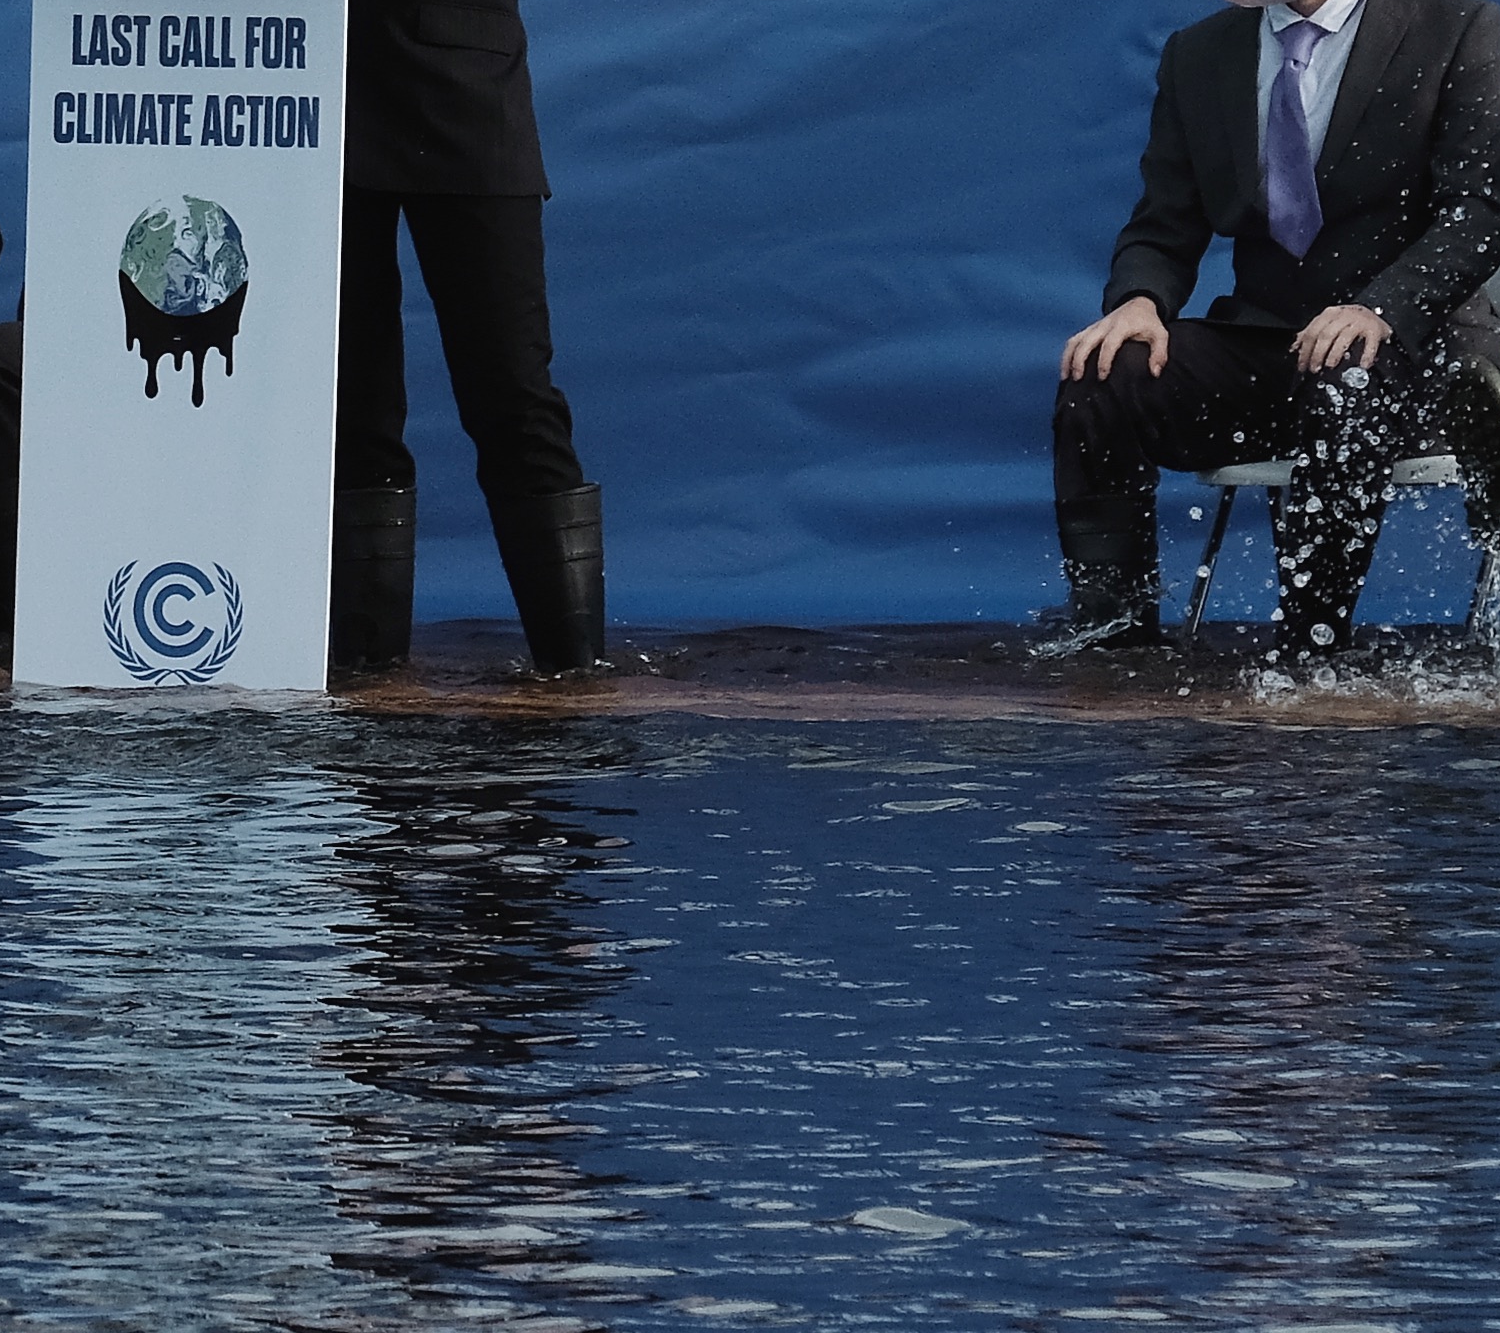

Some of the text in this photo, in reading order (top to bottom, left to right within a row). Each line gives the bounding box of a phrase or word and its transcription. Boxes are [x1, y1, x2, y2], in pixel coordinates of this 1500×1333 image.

[72, 15, 306, 70] LAST CALL FOR
[54, 92, 320, 149] CLIMATE ACTION
